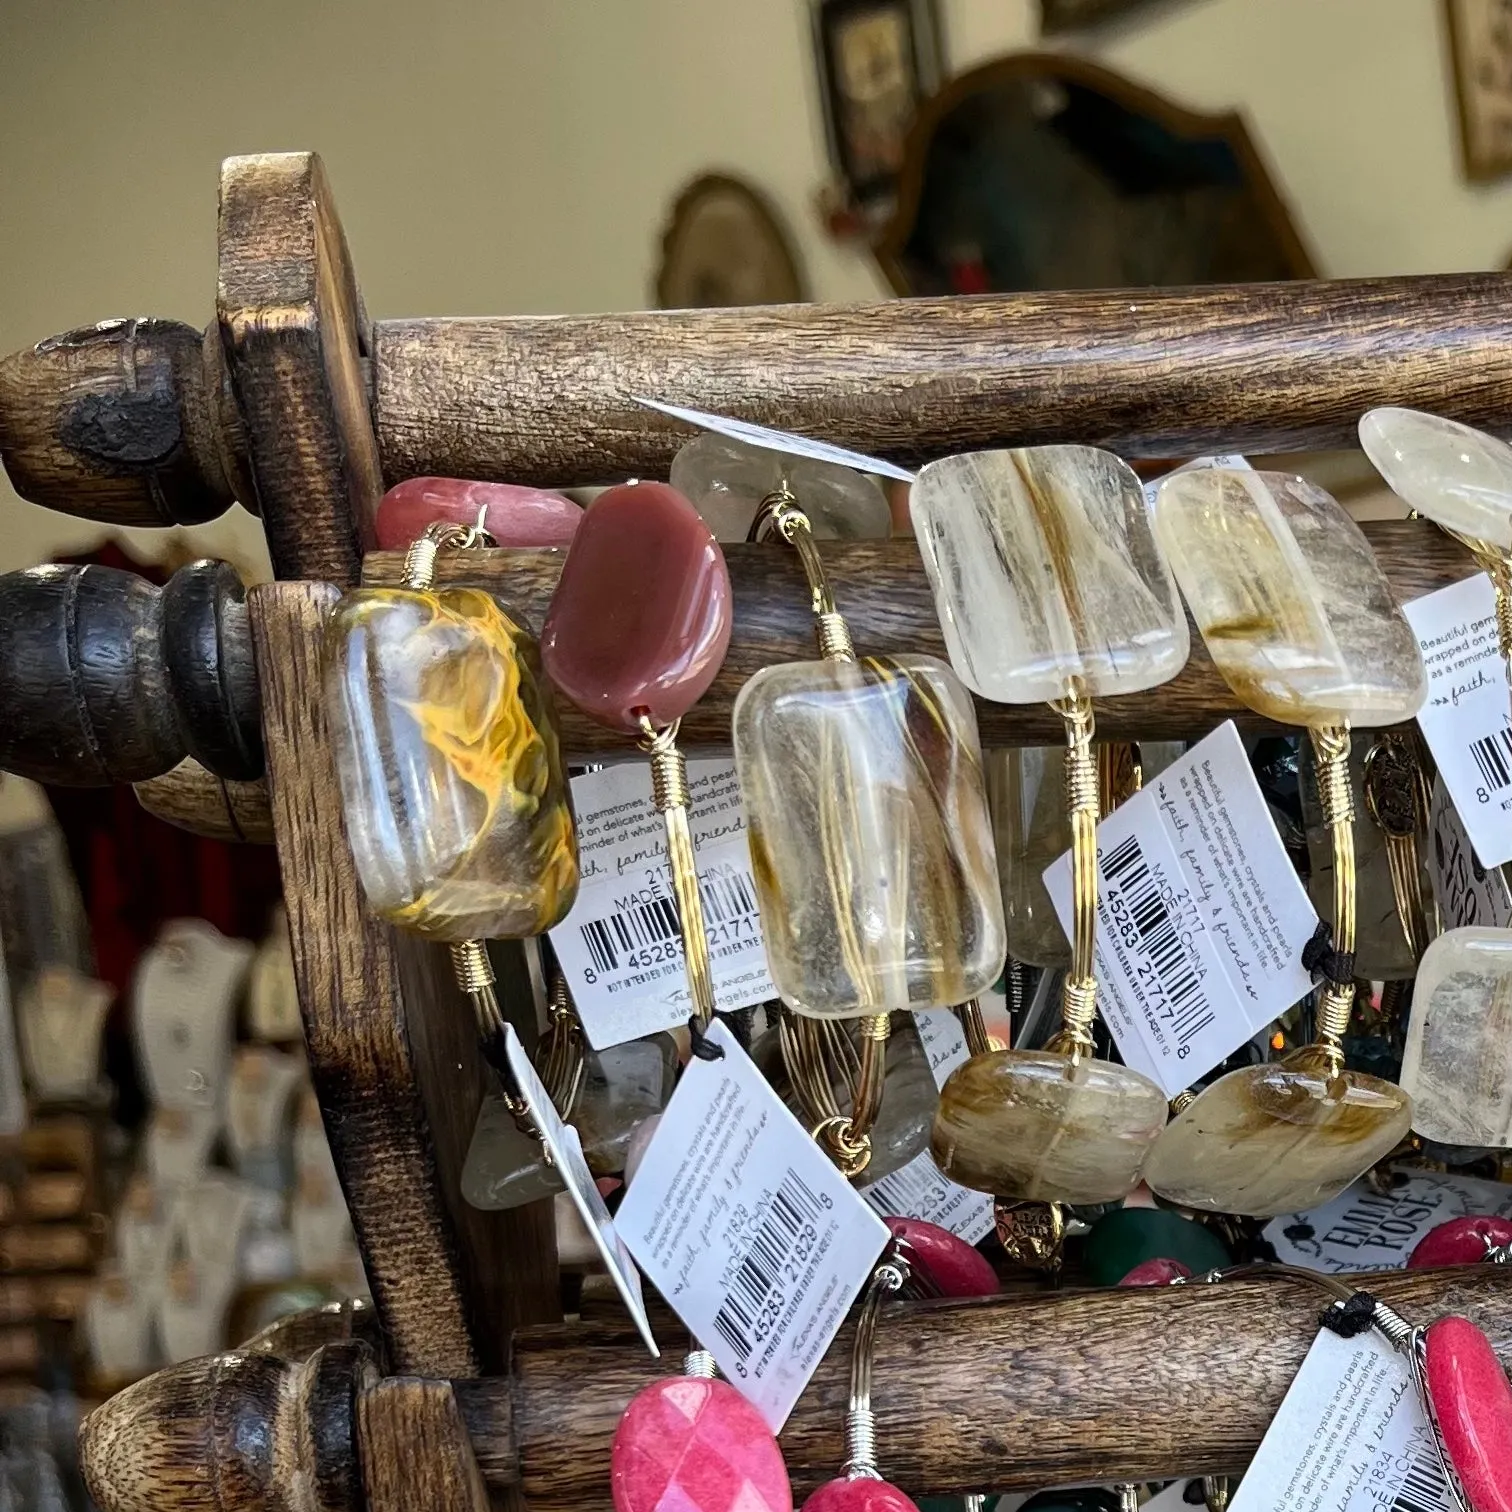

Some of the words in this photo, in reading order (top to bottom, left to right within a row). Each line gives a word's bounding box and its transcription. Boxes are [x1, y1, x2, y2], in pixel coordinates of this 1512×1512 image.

[1419, 623, 1468, 651] Beautiful
[1470, 634, 1486, 646] on
[1430, 668, 1443, 679] as
[1446, 667, 1499, 706] faith,
[1200, 759, 1226, 805] Beautiful
[1474, 786, 1490, 805] 8
[585, 795, 648, 824] gemstones,
[586, 826, 601, 836] on
[602, 811, 645, 831] delicate
[616, 830, 629, 841] of
[629, 820, 662, 837] what's
[717, 800, 729, 811] in
[1217, 804, 1253, 865] gemstones,
[1184, 764, 1214, 811] wrapped
[1207, 810, 1218, 825] on
[1214, 824, 1239, 865] delicate
[1232, 864, 1249, 888] wire
[1242, 889, 1255, 906] are
[1250, 905, 1286, 971] handcrafted
[1187, 795, 1215, 842] reminder
[1208, 841, 1220, 855] of
[1225, 886, 1258, 940] important
[1250, 937, 1263, 949] in
[1243, 863, 1270, 903] crystals
[613, 884, 663, 911] MADE
[1175, 887, 1206, 934] 21717
[1179, 845, 1219, 903] family
[1211, 918, 1255, 983] friends
[1263, 901, 1280, 924] and
[1148, 863, 1179, 911] MADE
[1170, 912, 1187, 930] IN
[1179, 930, 1211, 981] CHINA
[1270, 924, 1295, 959] pearls
[582, 967, 598, 984] 8
[1102, 888, 1140, 949] 45283
[1136, 961, 1174, 1022] 21717
[1175, 1043, 1192, 1060] 8
[1129, 975, 1147, 1003] UNDER
[745, 1186, 774, 1233] CHINA
[1363, 1192, 1443, 1250] ROSE
[738, 1229, 754, 1247] IN
[717, 1246, 746, 1290] MADE
[732, 1361, 750, 1379] 8
[749, 1287, 786, 1344] 45283
[780, 1222, 819, 1281] 21829
[816, 1191, 834, 1209] 8
[1340, 1350, 1378, 1412] handcrafted
[1365, 1384, 1378, 1396] in
[1280, 1439, 1320, 1501] gemstones,
[1310, 1401, 1339, 1442] crystals
[1330, 1380, 1347, 1402] and
[1340, 1348, 1366, 1382] pearls
[1334, 1412, 1347, 1430] are
[1340, 1395, 1375, 1448] important
[1320, 1429, 1338, 1453] wire
[1394, 1422, 1429, 1474] CHINA
[1299, 1452, 1327, 1495] delicate
[1323, 1445, 1347, 1479] what's
[1361, 1449, 1396, 1498] 21834
[1385, 1472, 1404, 1491] IN
[1293, 1494, 1306, 1510] on
[1317, 1477, 1330, 1491] of
